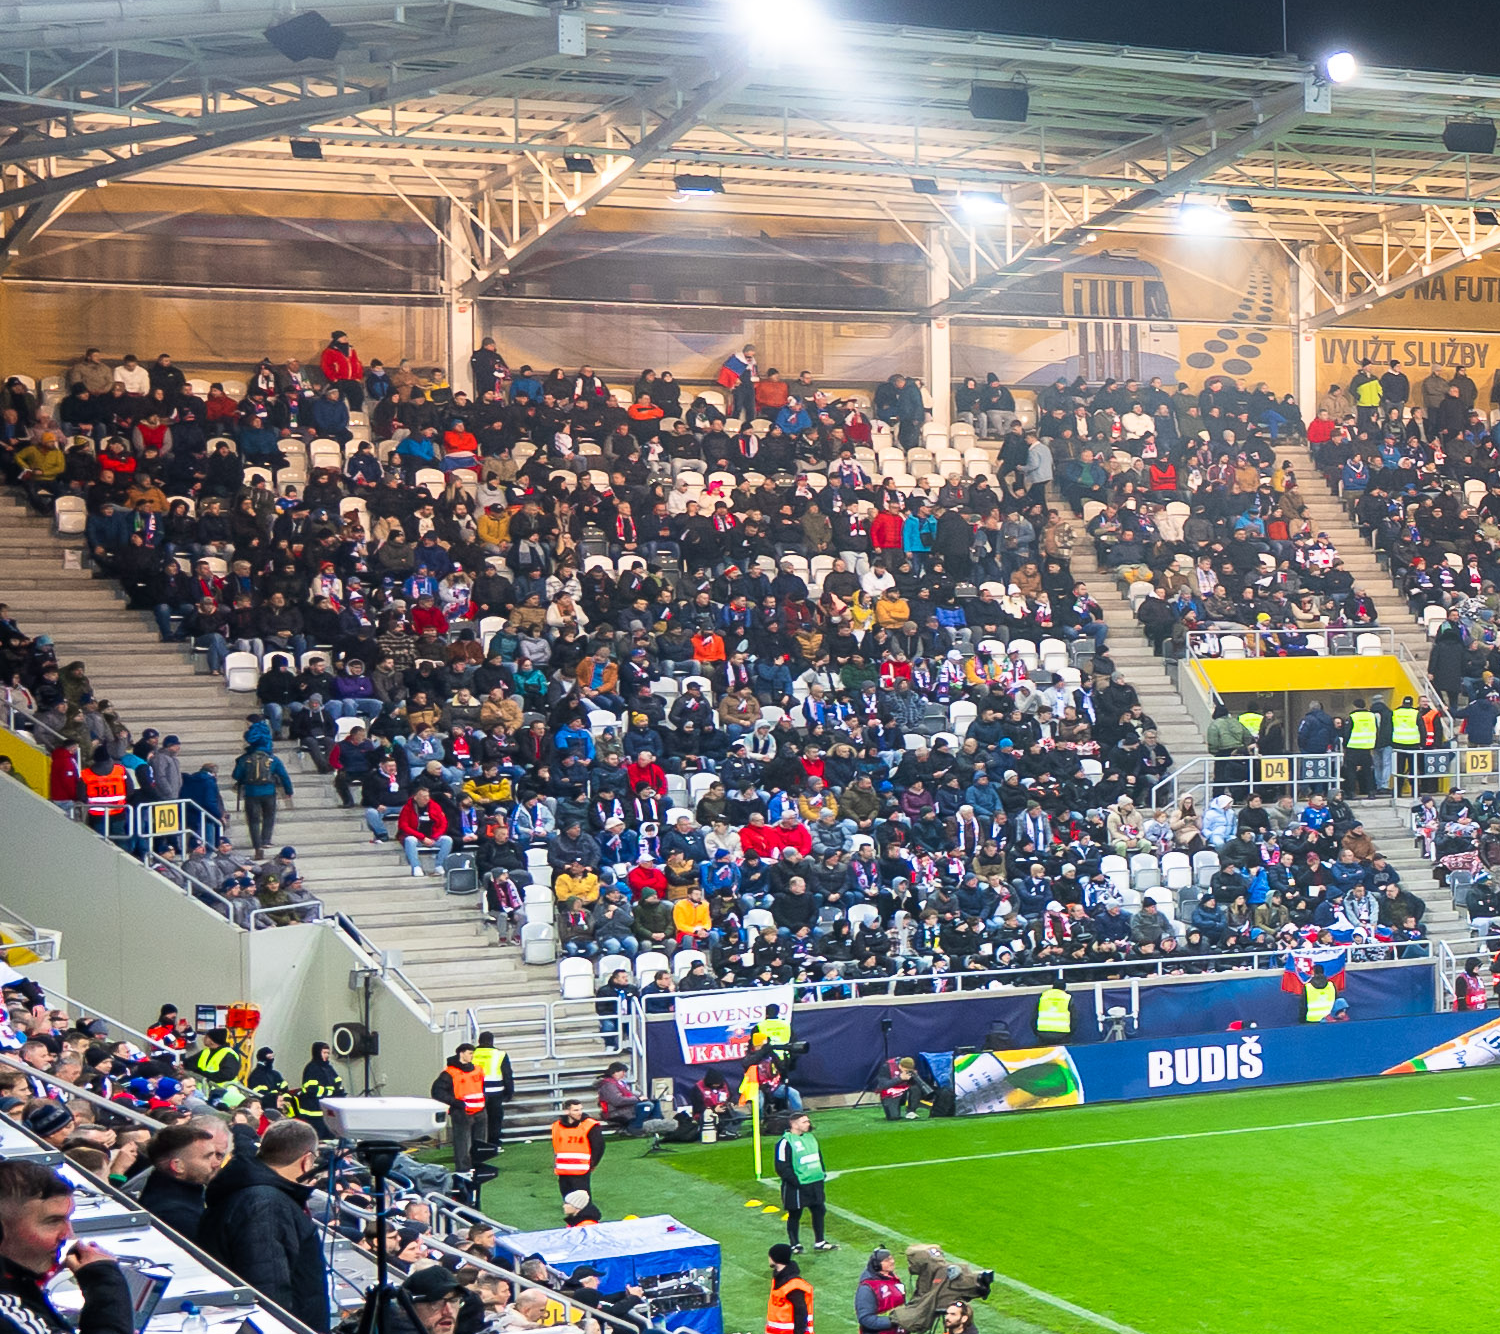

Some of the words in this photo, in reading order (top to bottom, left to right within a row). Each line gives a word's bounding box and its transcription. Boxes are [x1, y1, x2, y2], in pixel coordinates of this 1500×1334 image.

[1414, 276, 1447, 302] NA
[1403, 337, 1489, 368] SLUŽBY
[1265, 763, 1285, 778] D4
[1471, 754, 1487, 769] D3
[159, 808, 175, 826] AD
[684, 1003, 788, 1025] LOVENSO
[1148, 1035, 1263, 1088] BUDIŠ
